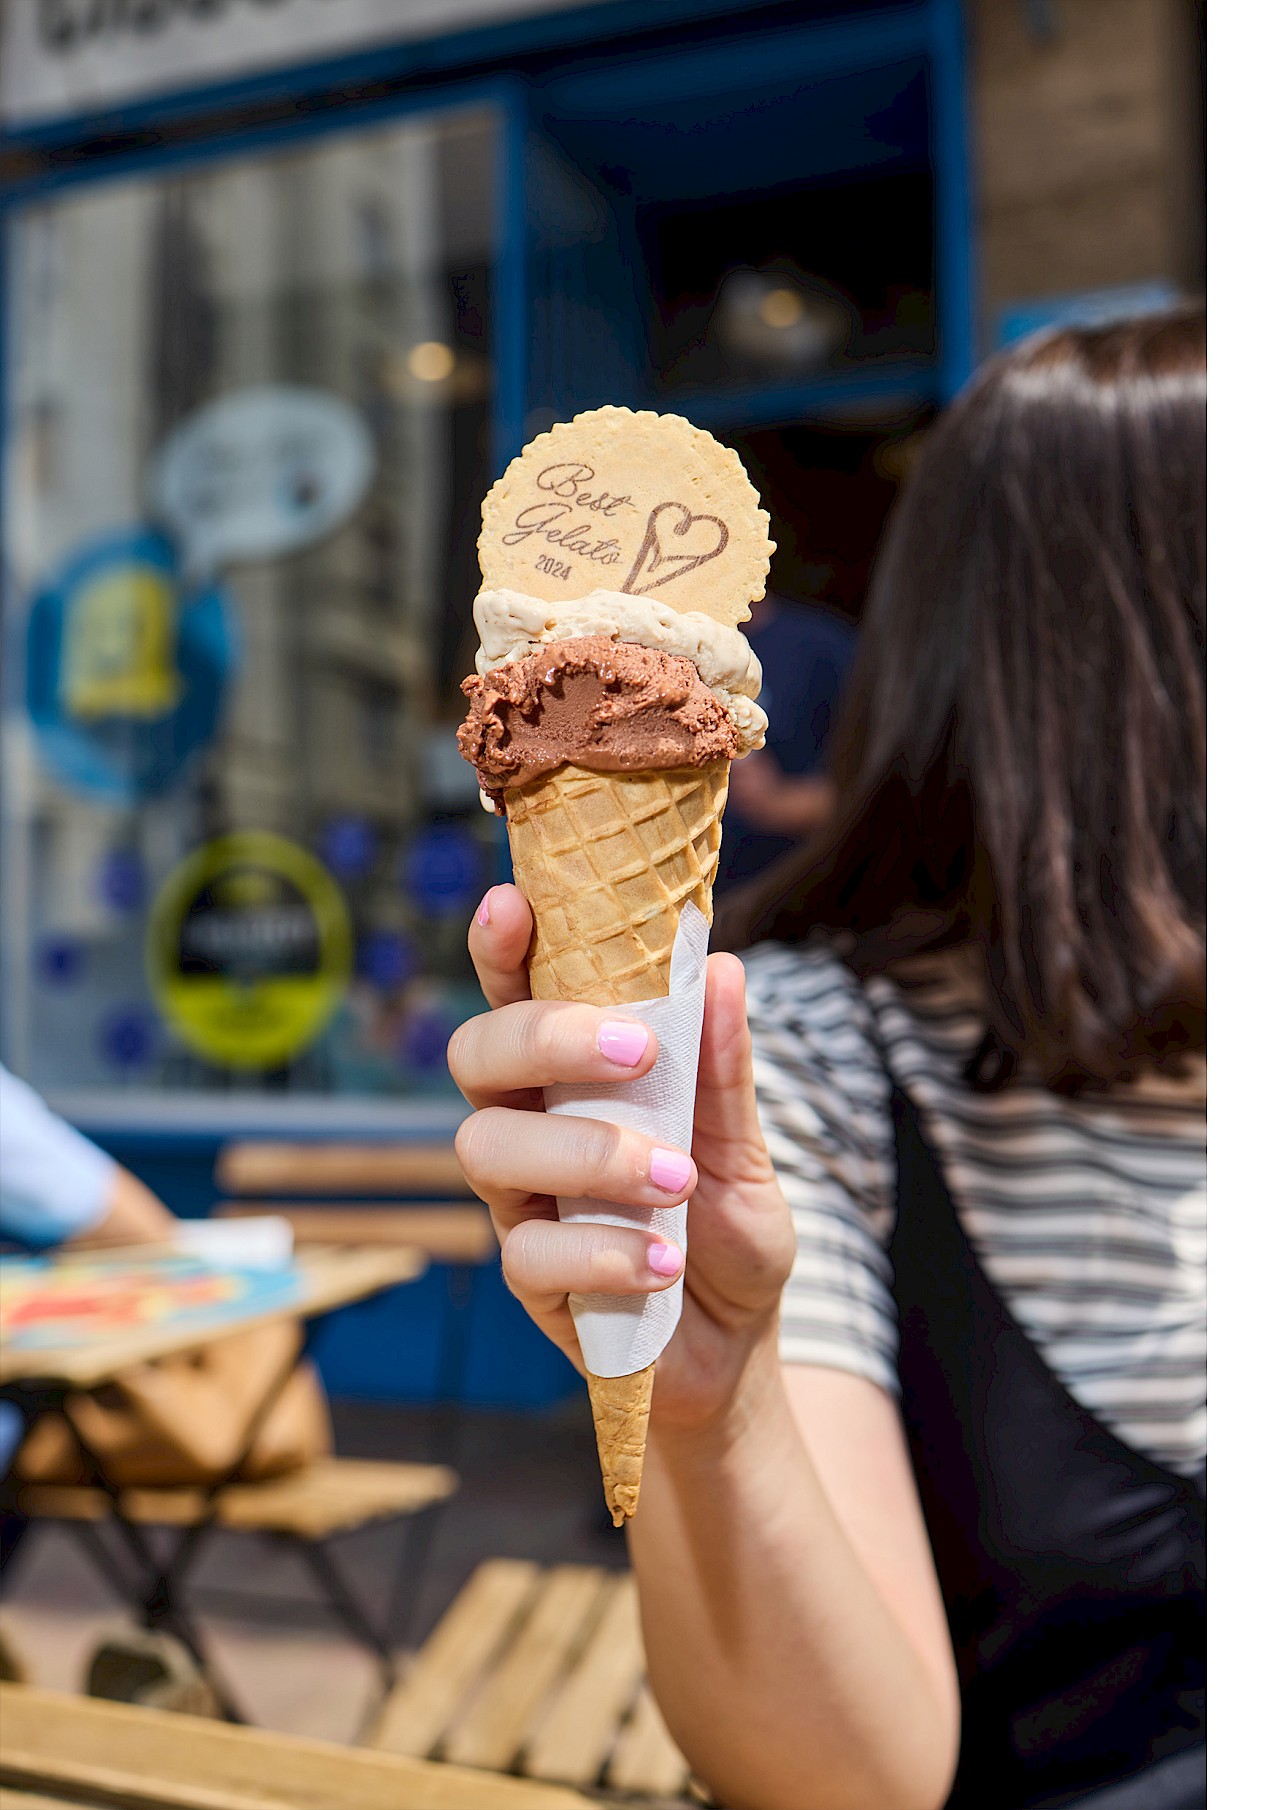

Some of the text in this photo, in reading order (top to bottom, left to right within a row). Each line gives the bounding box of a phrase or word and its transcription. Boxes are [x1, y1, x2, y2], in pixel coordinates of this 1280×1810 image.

[536, 462, 633, 517] Best
[501, 501, 623, 565] Gelato
[534, 553, 572, 581] 2024
